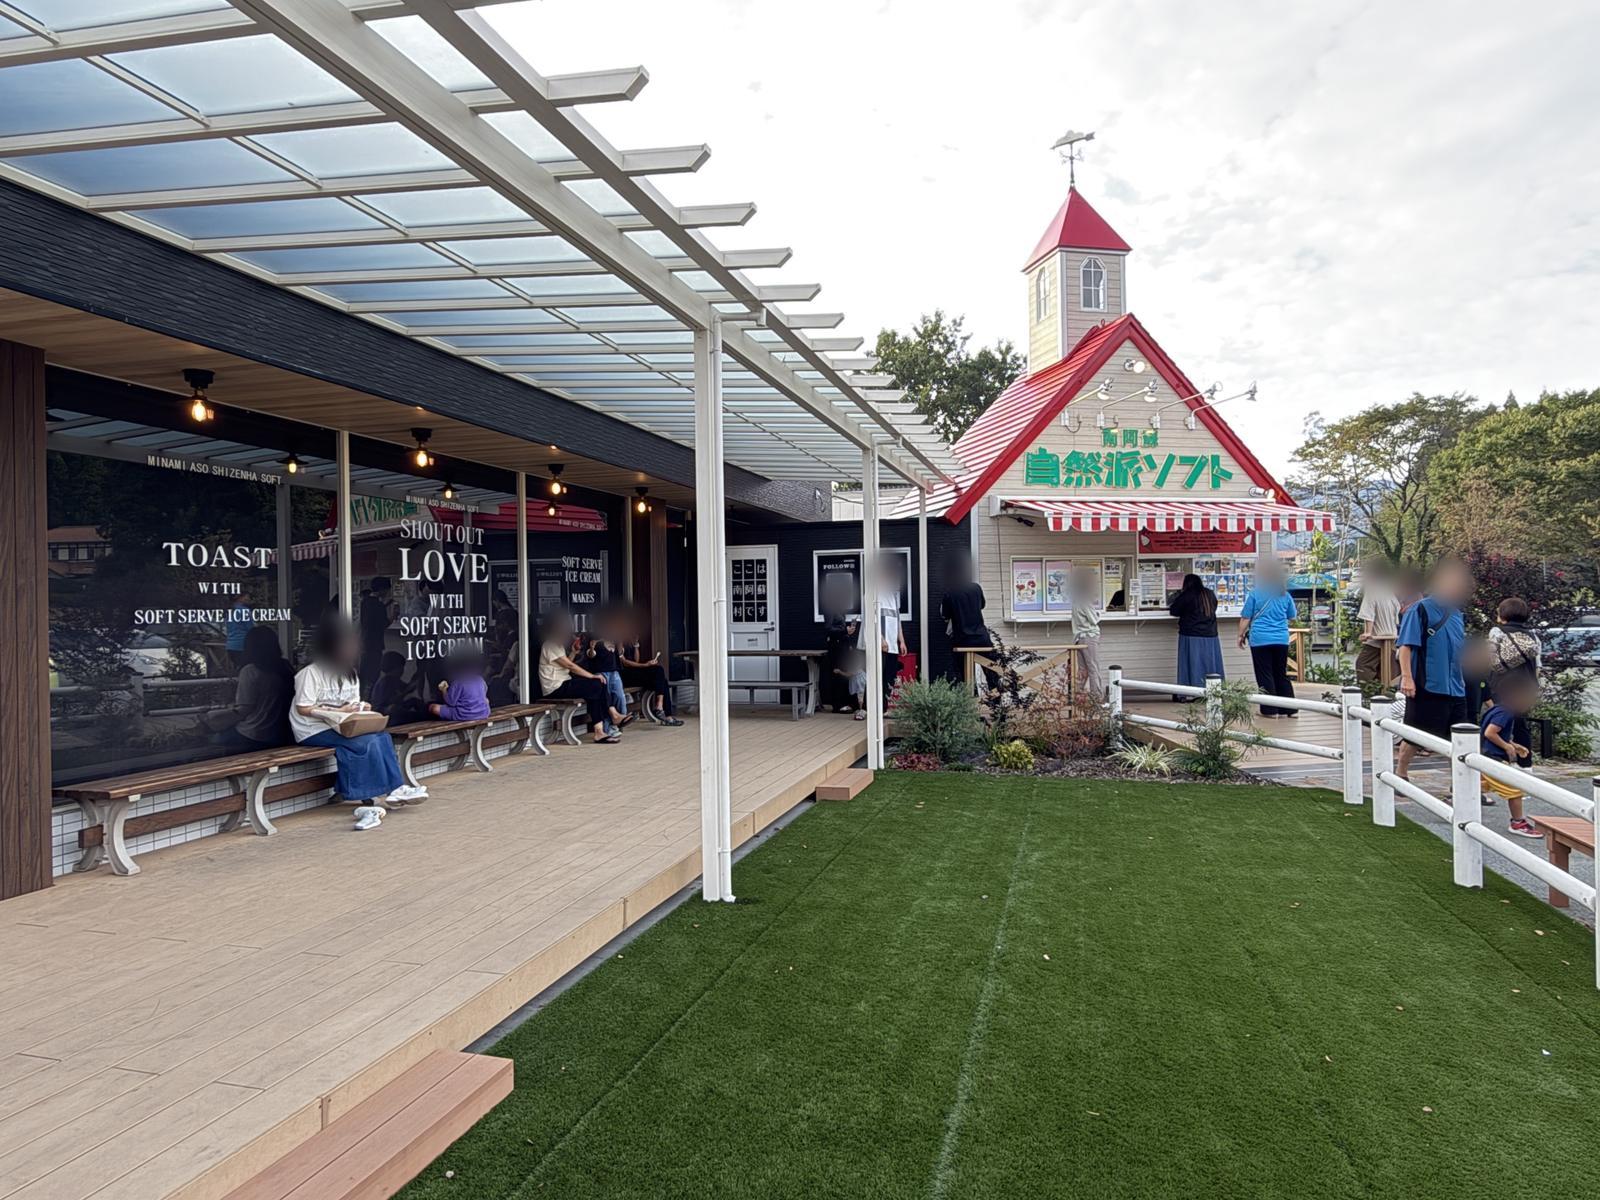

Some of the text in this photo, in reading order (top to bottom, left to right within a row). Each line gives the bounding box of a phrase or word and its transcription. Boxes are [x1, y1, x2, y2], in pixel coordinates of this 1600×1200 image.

[147, 455, 282, 484] MINAMI ASO SHIZENHA SOFT
[1024, 446, 1234, 490] 自然派ソフト
[400, 518, 484, 545] SHOUT OUT
[162, 542, 272, 569] TOAST
[562, 556, 603, 570] SOFT SERVE
[398, 547, 489, 583] LOVE
[734, 564, 766, 574] ここは
[564, 570, 578, 583] ICE
[580, 572, 601, 584] CREAM
[198, 582, 241, 595] WITH
[429, 594, 464, 608] WITH
[572, 593, 595, 604] MAKES
[134, 608, 292, 625] SOFT SERVE ICE CREAM
[734, 606, 767, 616] 村です
[400, 616, 487, 636] SOFT SERVE
[406, 640, 436, 660] ICE
